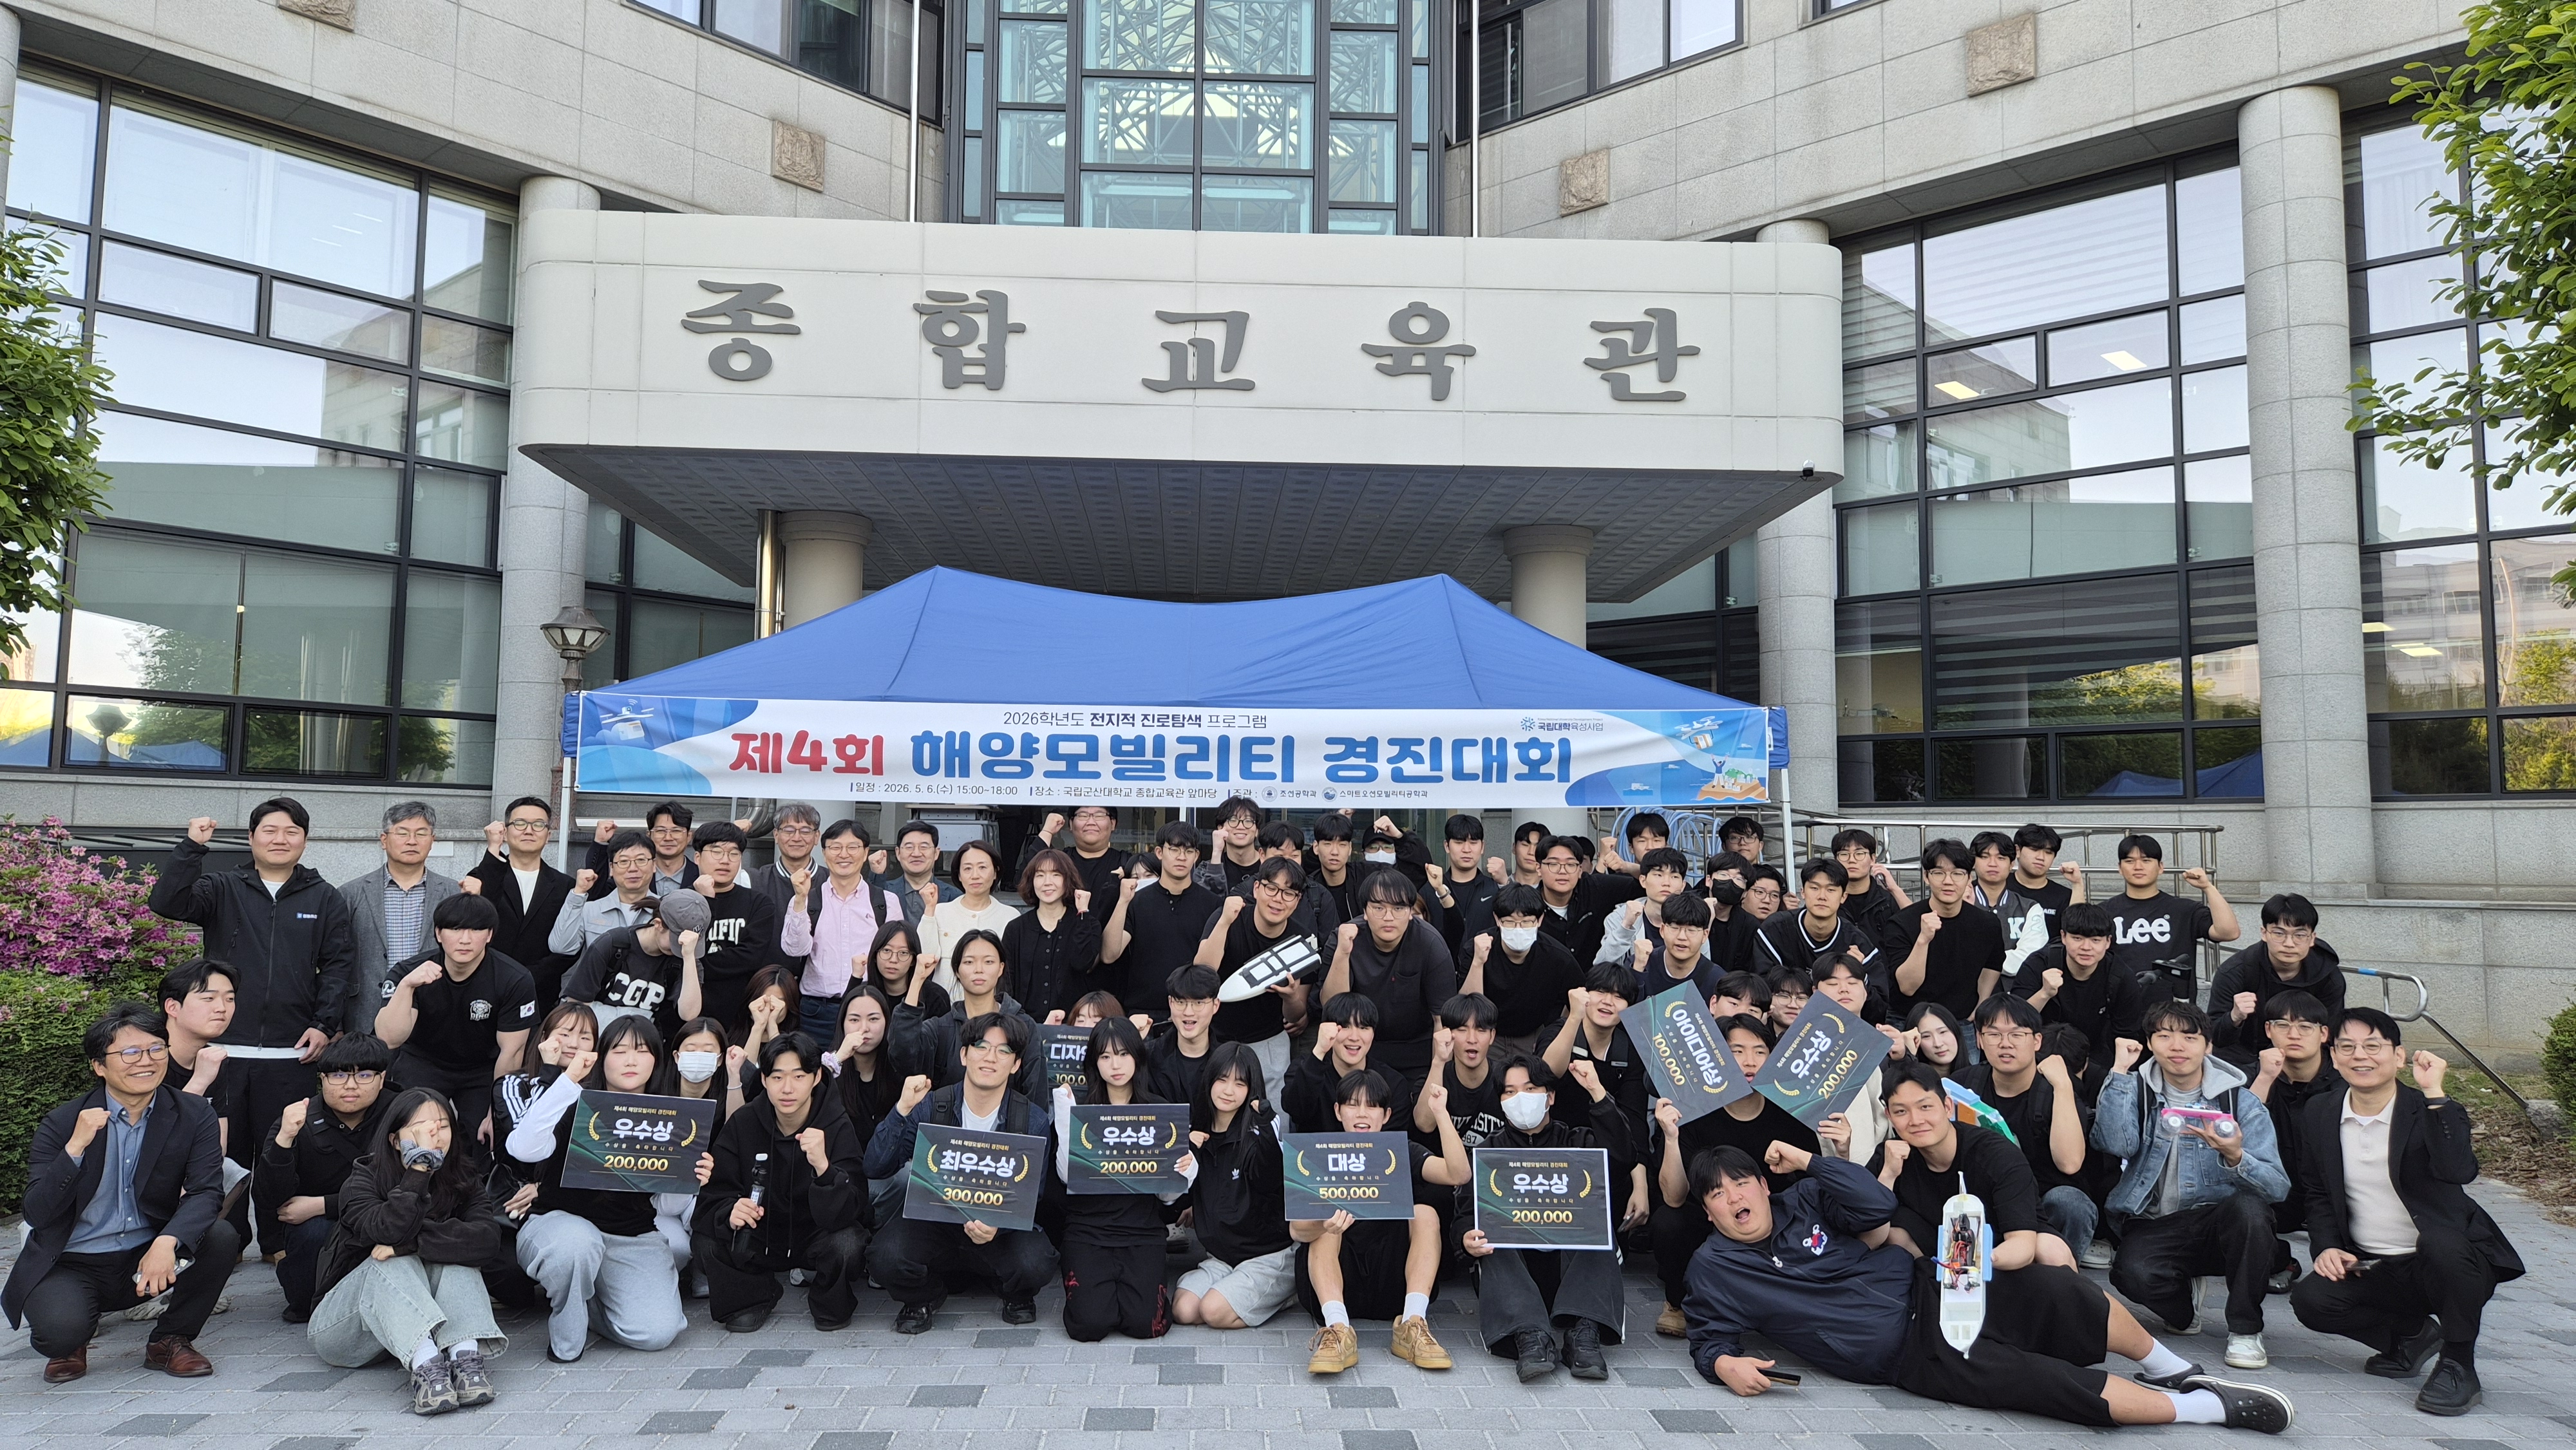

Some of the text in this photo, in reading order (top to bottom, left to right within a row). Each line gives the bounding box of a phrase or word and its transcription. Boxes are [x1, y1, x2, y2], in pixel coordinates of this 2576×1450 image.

[681, 279, 1701, 402] 종합교육관
[1003, 711, 1267, 728] 2026학년도 전지적 진로탐색 프로그램
[1537, 722, 1604, 731] 국립대학육성사업
[728, 730, 1572, 784] 제4회 해양모빌리티 경진대회
[855, 782, 875, 793] 일정
[884, 783, 911, 793] 2026.
[914, 784, 924, 793] 5.
[956, 785, 1018, 795] 15:00~18:00
[1034, 786, 1055, 796] 장소
[1063, 786, 1132, 798] 국립군산대학교
[1135, 787, 1185, 798] 종합교육관
[1188, 787, 1218, 799] 앞마당
[1232, 789, 1253, 799] 주관
[1280, 789, 1317, 798] 조선공학과
[1340, 789, 1428, 798] 스마트오션모빌리티공학과
[2007, 917, 2025, 939] K
[2113, 916, 2171, 945] Lee
[1672, 1008, 1723, 1086] 아이디어상
[1790, 1030, 1832, 1079] 우수상
[1652, 1032, 1685, 1086] 100,000
[1056, 1073, 1088, 1086] 100,0
[1818, 1050, 1858, 1100] 200,000
[612, 1118, 674, 1142] 우수상
[1103, 1126, 1156, 1145] 우수상
[603, 1154, 669, 1172] 200,000
[940, 1149, 1016, 1178] 최우수상
[1100, 1161, 1157, 1174] 200,000
[1328, 1153, 1366, 1172] 대상
[1513, 1173, 1569, 1194] 우수상
[942, 1187, 1003, 1206] 300,000
[1319, 1187, 1379, 1200] 500,000
[1511, 1210, 1573, 1225] 200,000
